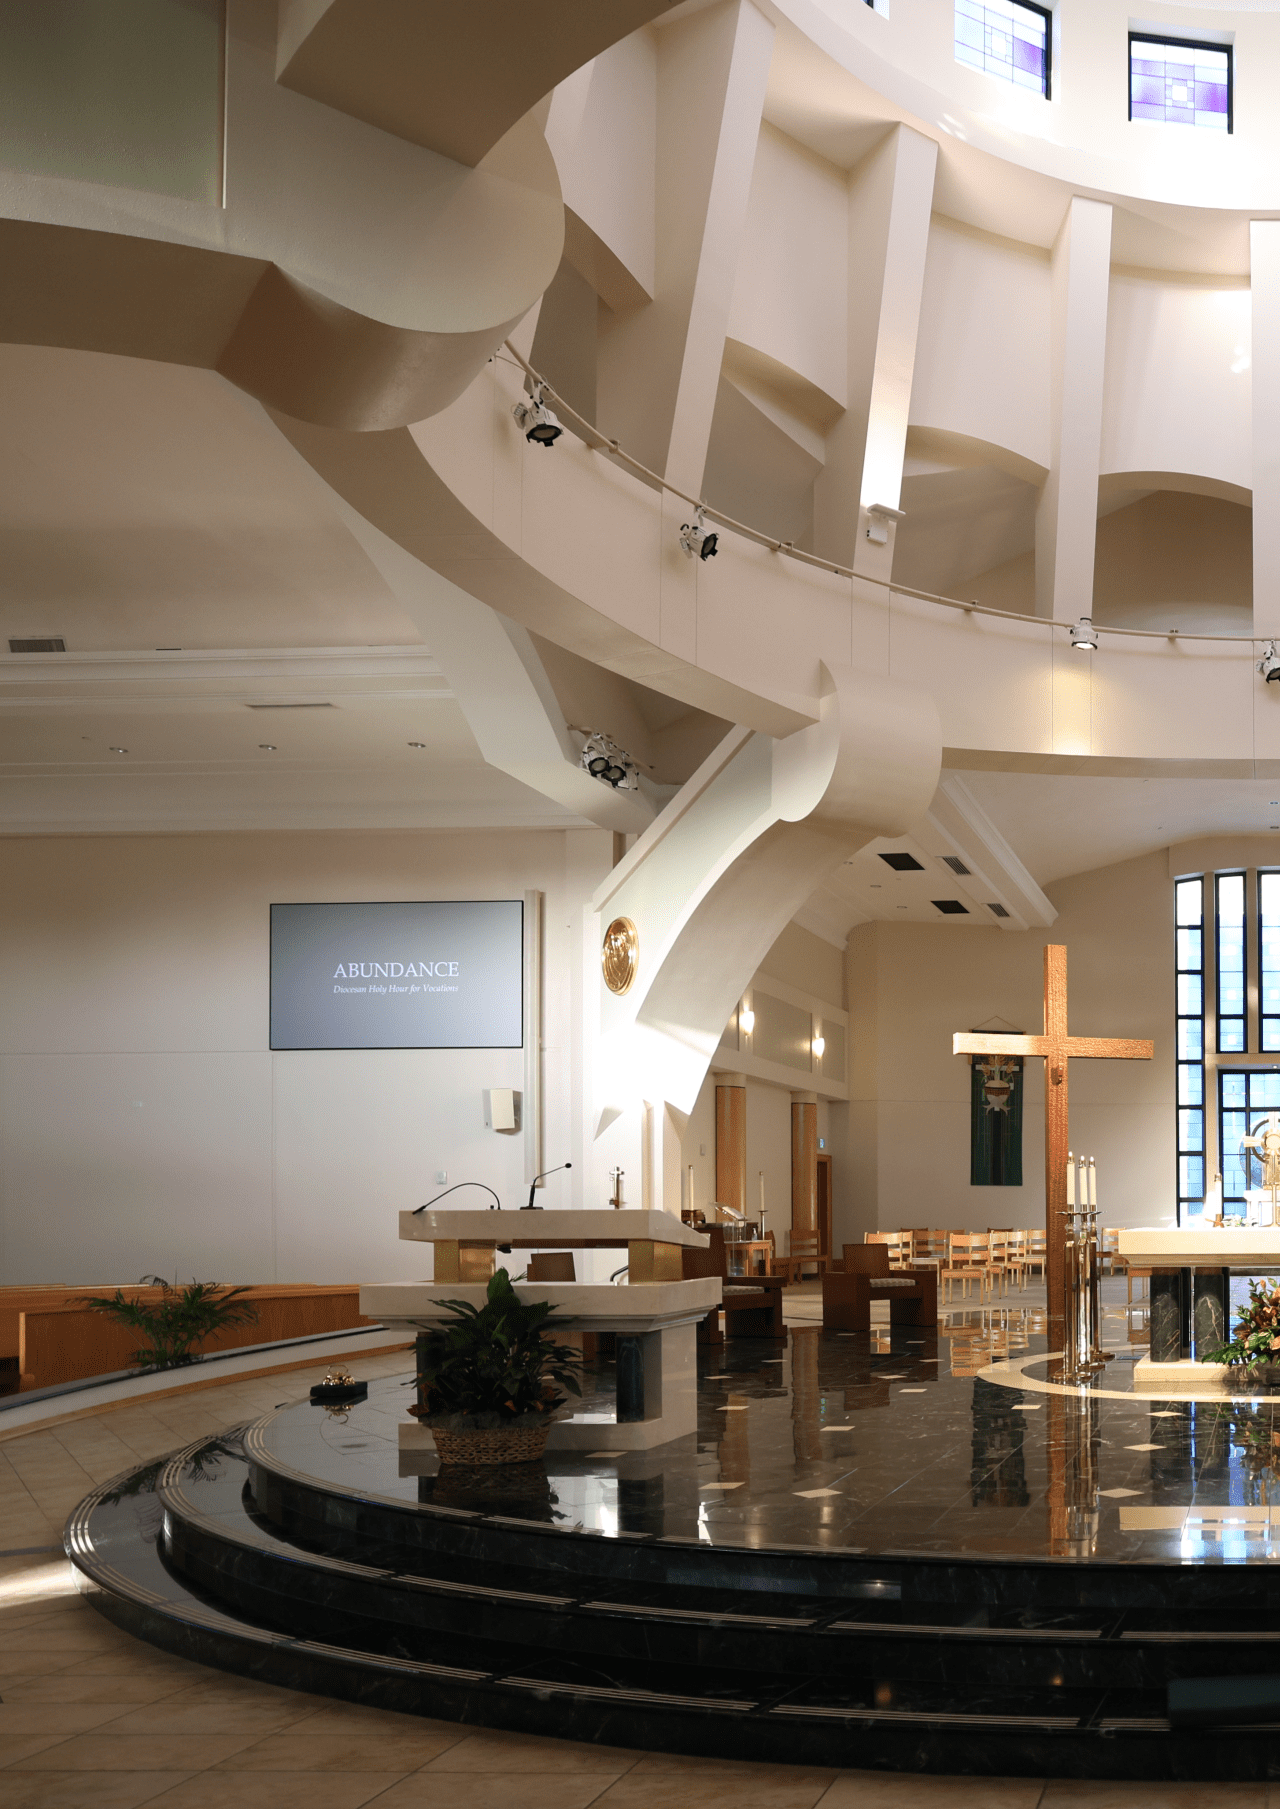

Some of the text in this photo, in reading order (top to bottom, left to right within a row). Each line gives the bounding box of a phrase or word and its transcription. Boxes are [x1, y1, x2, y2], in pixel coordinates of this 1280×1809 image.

[333, 961, 460, 978] ABUNDANCE
[333, 983, 459, 995] Diocesan Holy Hour for Vocations
